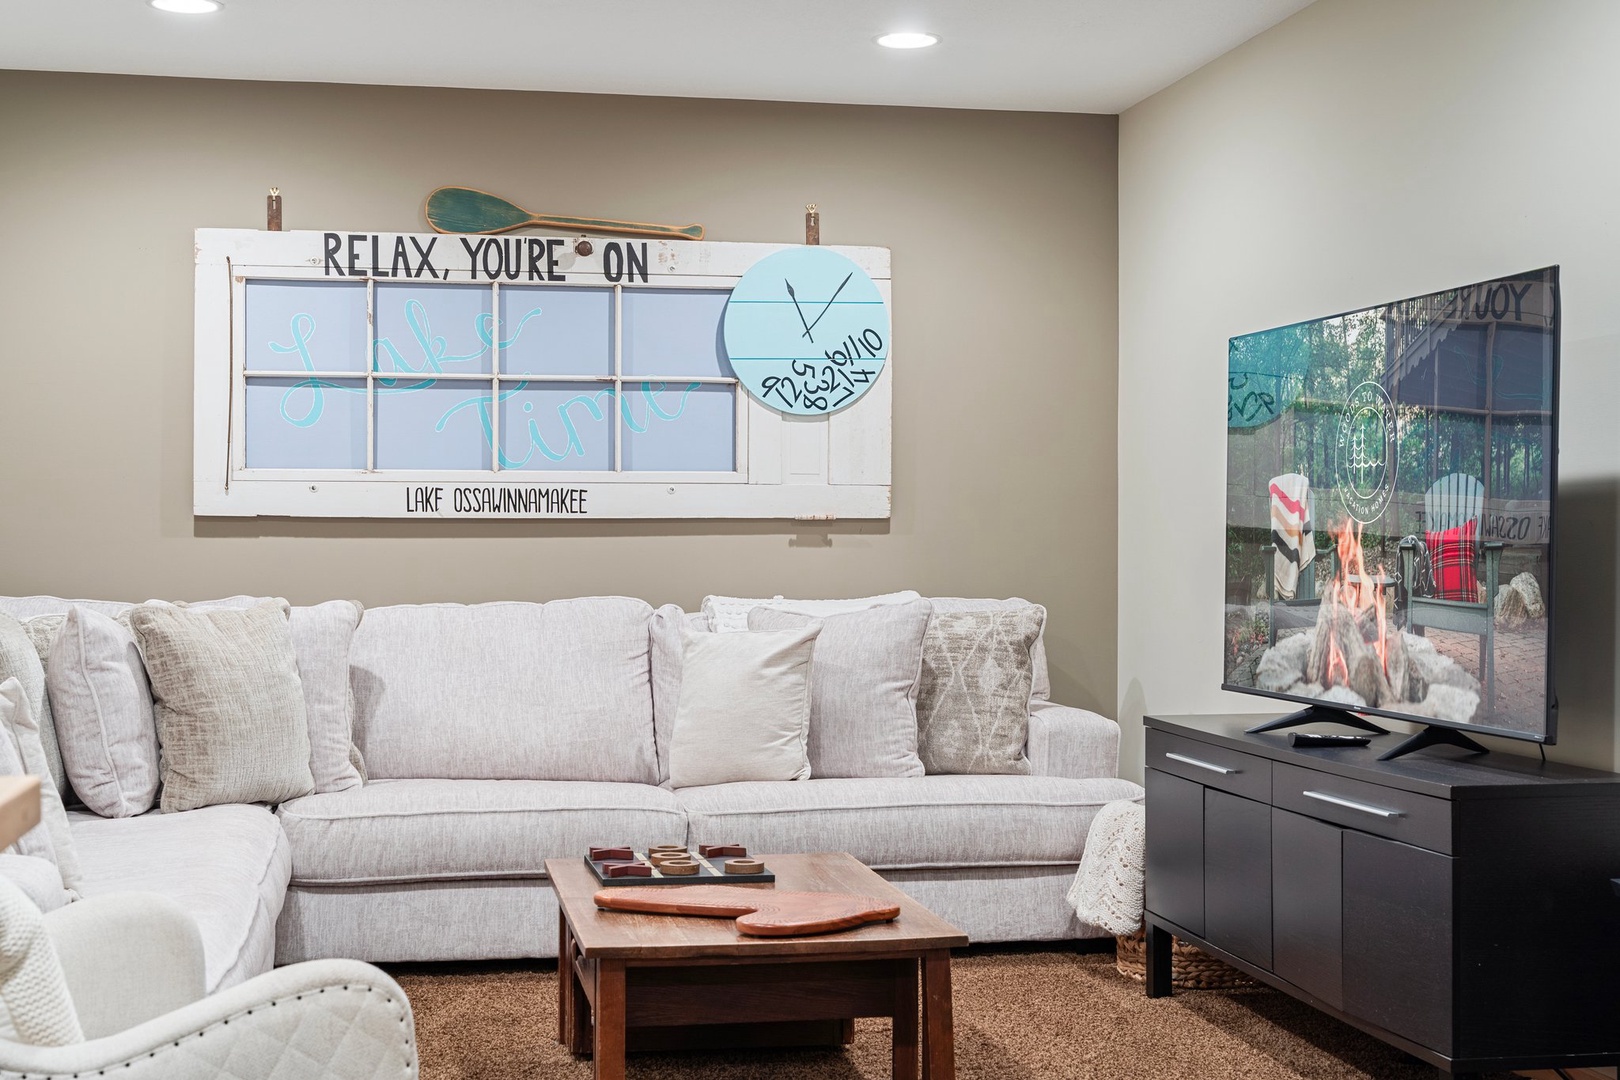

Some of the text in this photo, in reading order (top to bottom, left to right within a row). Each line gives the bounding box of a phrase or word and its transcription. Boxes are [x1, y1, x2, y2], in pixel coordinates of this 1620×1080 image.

[323, 232, 649, 283] RELAX, YOU'RE ON
[857, 328, 883, 358] 10
[268, 299, 542, 428] Lake
[791, 359, 816, 379] 5
[850, 369, 876, 384] 4
[761, 376, 781, 398] 9
[775, 376, 803, 408] 12
[804, 380, 830, 395] 3
[822, 365, 841, 393] 2
[803, 394, 828, 411] 8
[832, 386, 855, 408] 7
[435, 372, 702, 469] Time
[1338, 390, 1395, 447] WOODS TO WATER
[406, 486, 588, 514] LAKE OSSAWINNAMAKEE
[1344, 483, 1390, 515] VACATION HOMES
